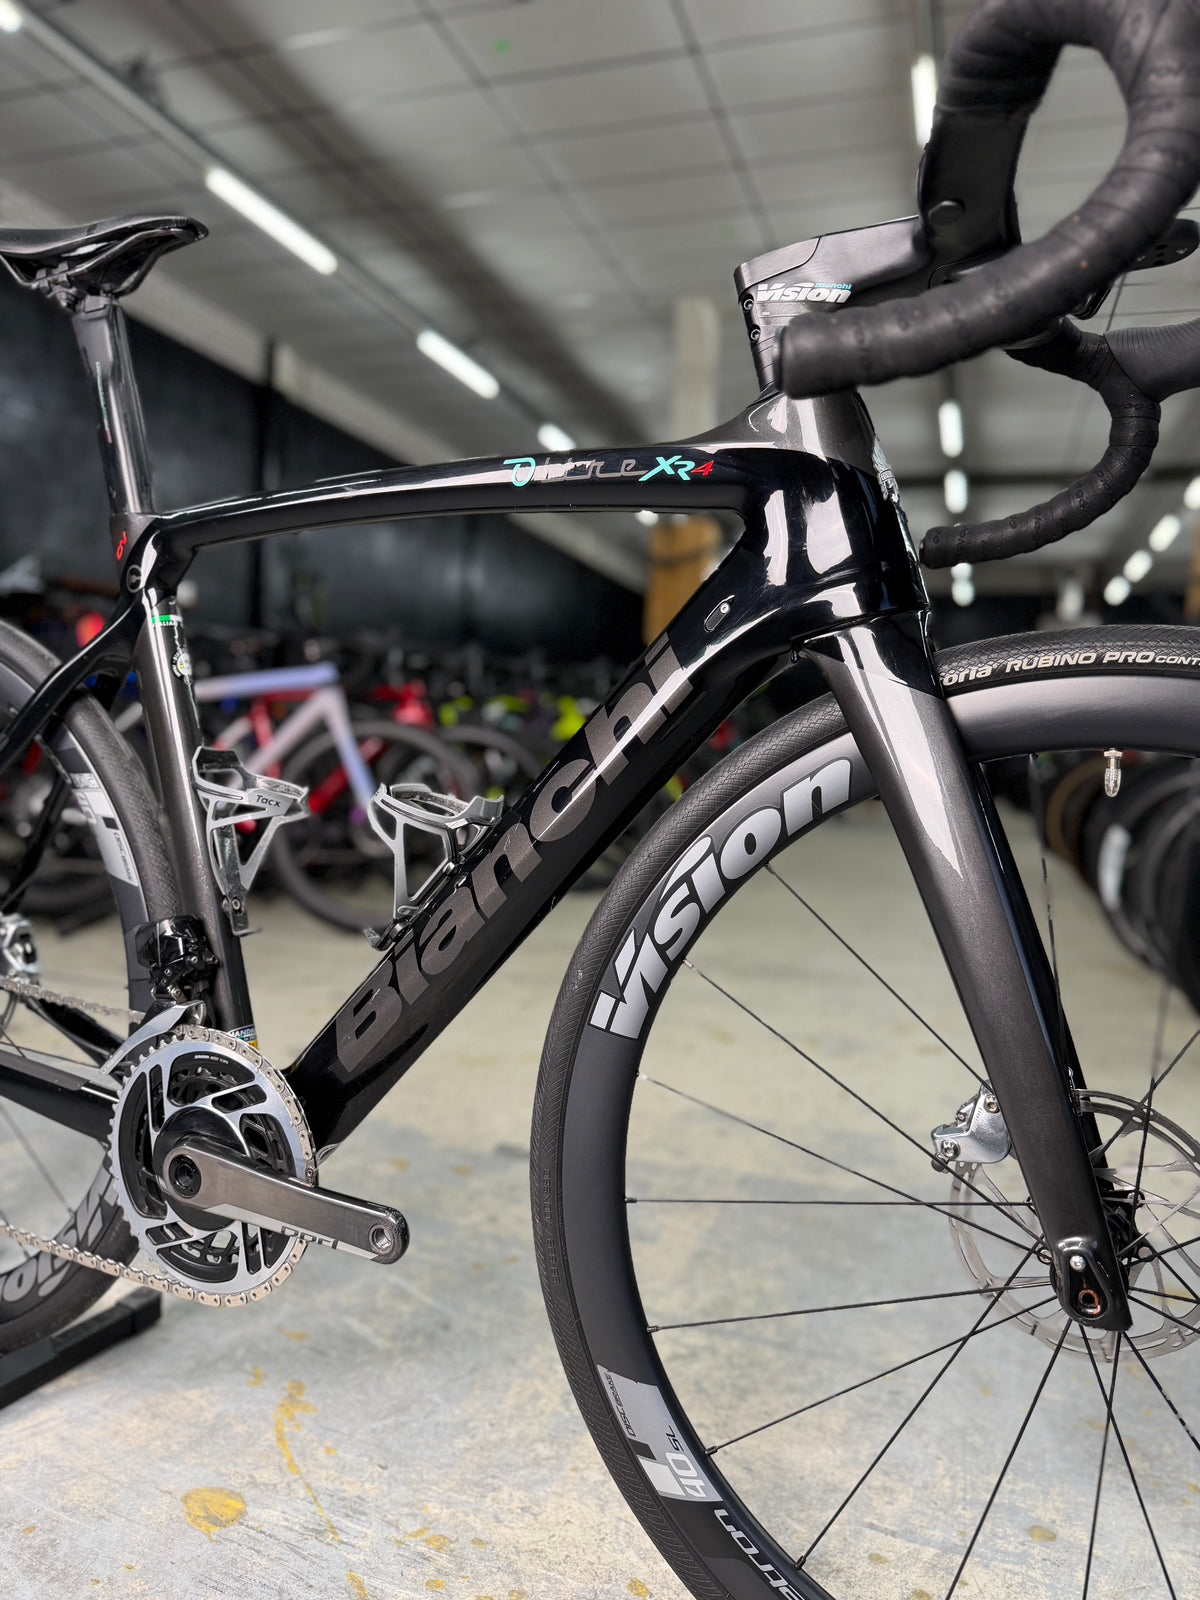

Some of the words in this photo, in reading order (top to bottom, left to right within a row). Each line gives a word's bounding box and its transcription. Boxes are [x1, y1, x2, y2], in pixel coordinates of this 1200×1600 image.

[756, 282, 852, 303] Vision
[638, 455, 714, 481] XR4
[1005, 653, 1097, 673] RUBINO
[1103, 651, 1155, 664] PRO
[1154, 655, 1200, 666] CONT
[255, 794, 281, 808] Tacx
[336, 632, 693, 1072] Bianchi
[589, 759, 851, 1039] Vision
[665, 1424, 685, 1452] SL
[665, 1452, 706, 1497] 40
[714, 1509, 806, 1600] etron
